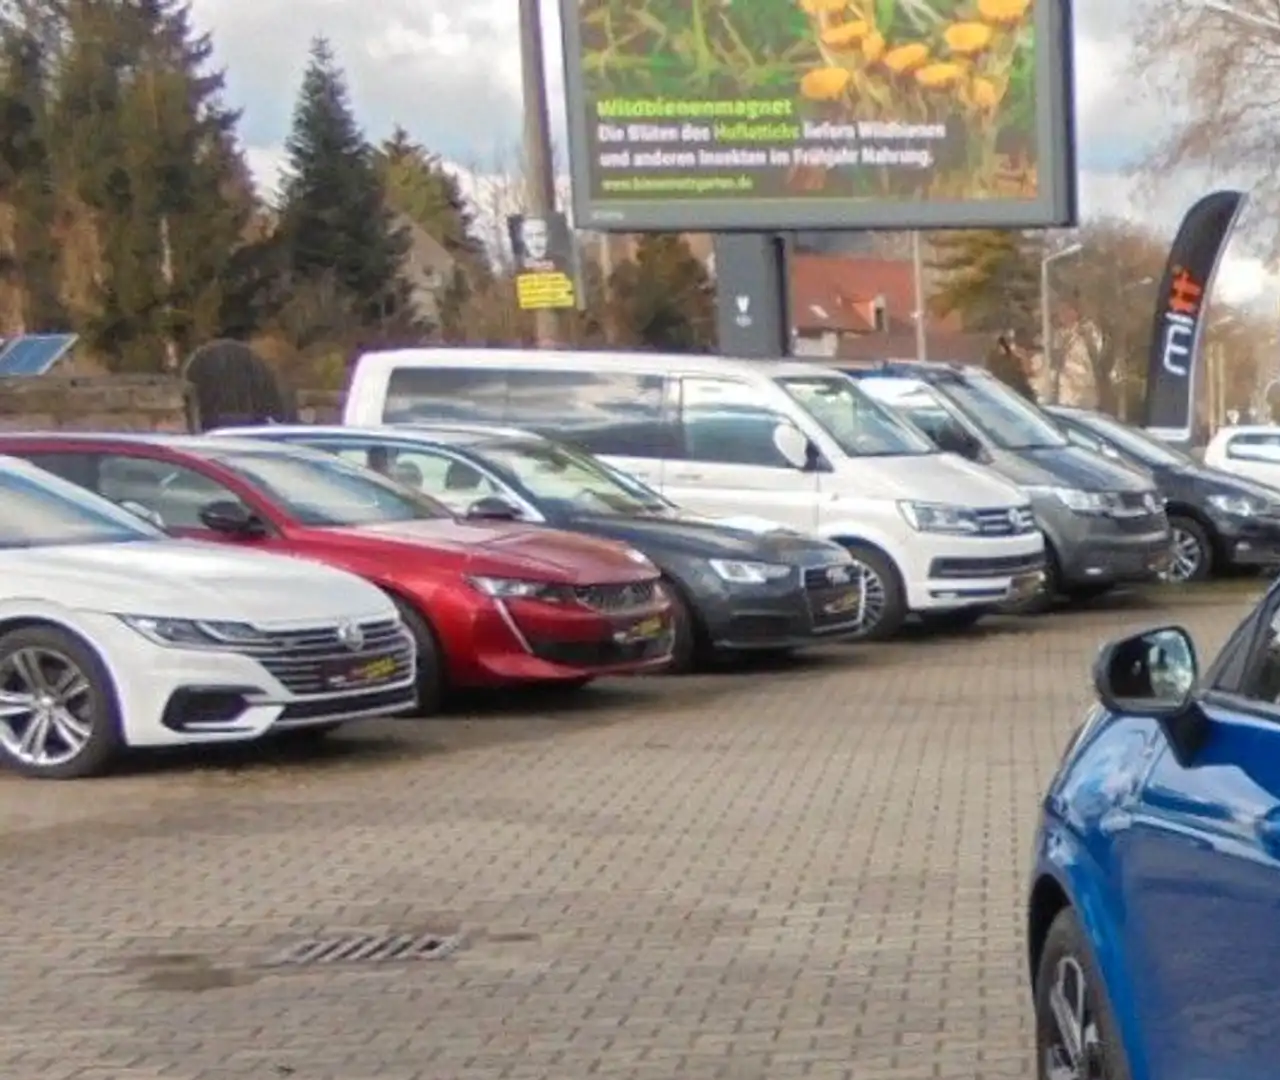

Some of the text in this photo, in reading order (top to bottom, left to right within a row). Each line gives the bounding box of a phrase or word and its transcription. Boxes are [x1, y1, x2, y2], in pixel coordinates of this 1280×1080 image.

[597, 98, 792, 118] Wildbienenmagnet
[598, 123, 625, 141] Die
[858, 121, 946, 139] Wildbienen
[600, 150, 630, 167] und
[633, 150, 696, 167] anderen
[770, 150, 790, 166] im
